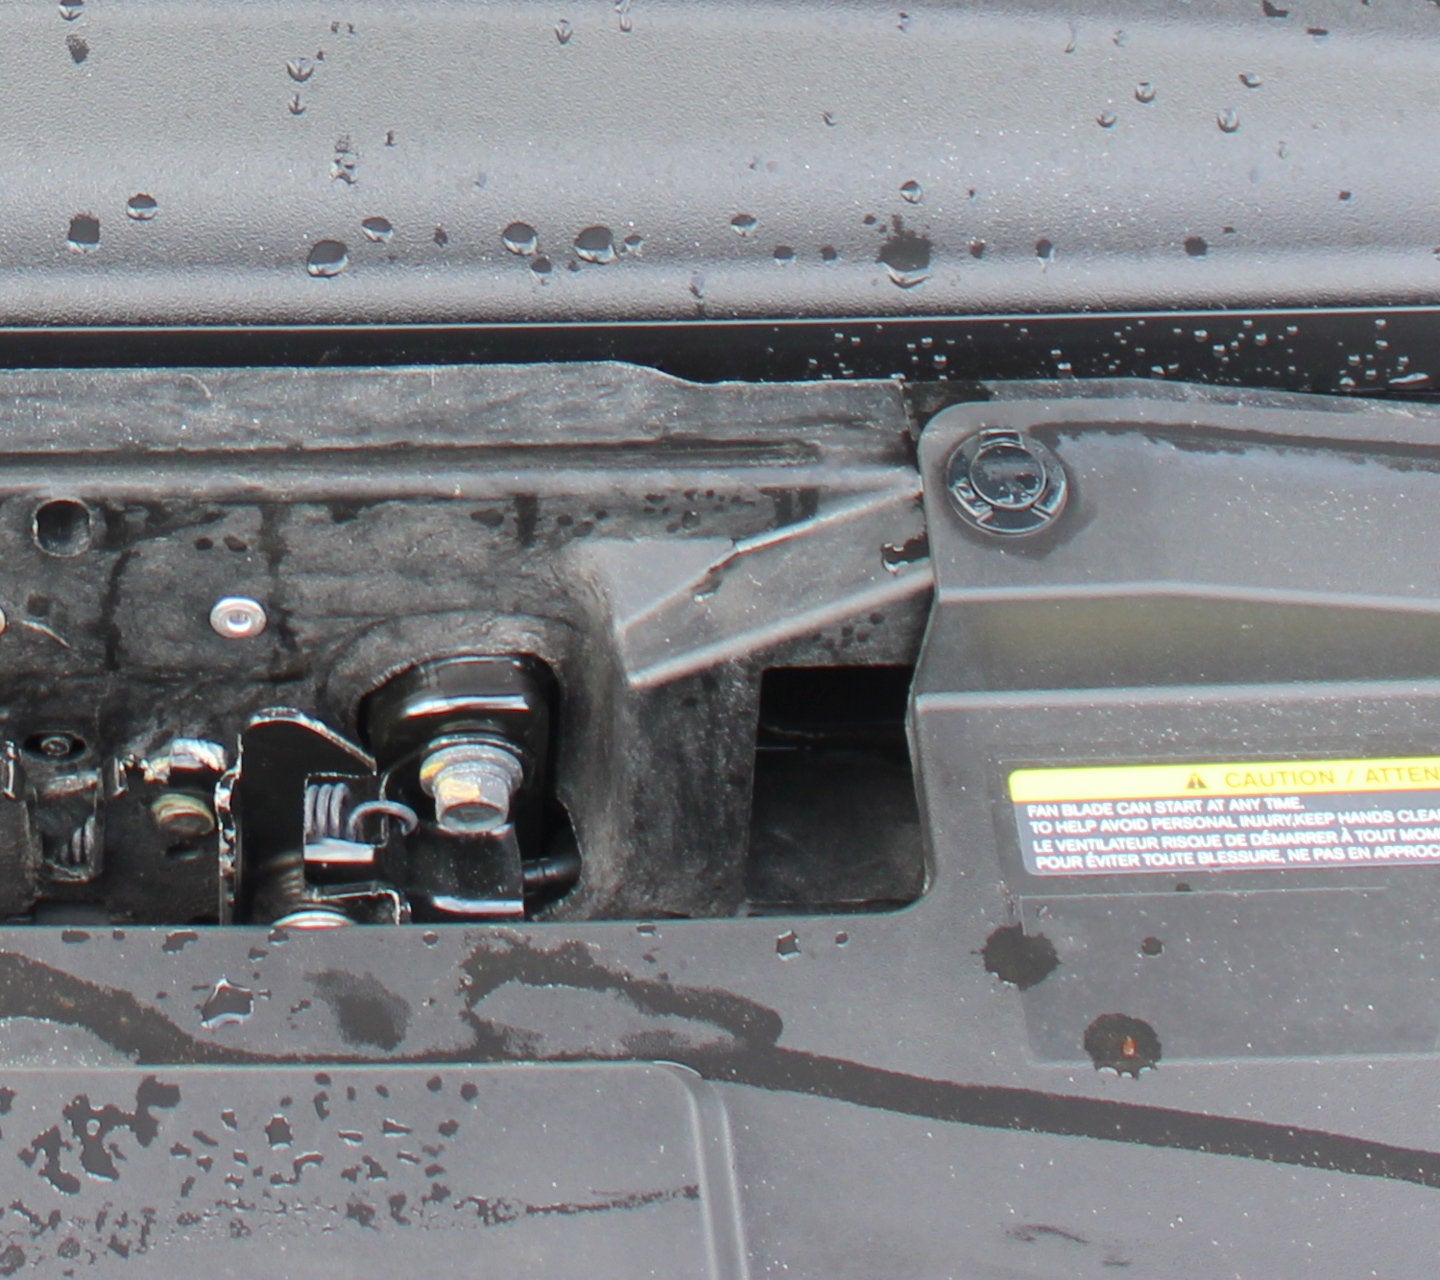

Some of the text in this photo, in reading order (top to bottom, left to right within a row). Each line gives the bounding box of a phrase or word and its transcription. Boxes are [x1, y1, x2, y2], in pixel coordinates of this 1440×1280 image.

[1224, 768, 1335, 789] CAUTION
[1026, 796, 1305, 818] FAN BLADE CAN START AT ANY TIME.
[1029, 820, 1053, 835] TO
[1056, 819, 1098, 834] HELP
[1100, 817, 1149, 833] AVOID
[1151, 815, 1238, 831] PERSONAL
[1337, 810, 1396, 825] HANDS
[1033, 839, 1054, 854] LE
[1055, 836, 1160, 852] VENTILATEUR
[1161, 834, 1220, 849] RISQUE
[1224, 832, 1249, 848] DE
[1250, 829, 1339, 846] DÉMARRER
[1339, 826, 1354, 843] À
[1354, 828, 1397, 843] TOUT
[1035, 855, 1084, 870] POUR
[1086, 852, 1141, 868] ÉVITER
[1143, 851, 1194, 867] TOUTE
[1197, 849, 1286, 866] BLESSURE,
[1287, 847, 1312, 862] NE
[1313, 846, 1346, 861] PAS
[1347, 845, 1370, 860] EN
